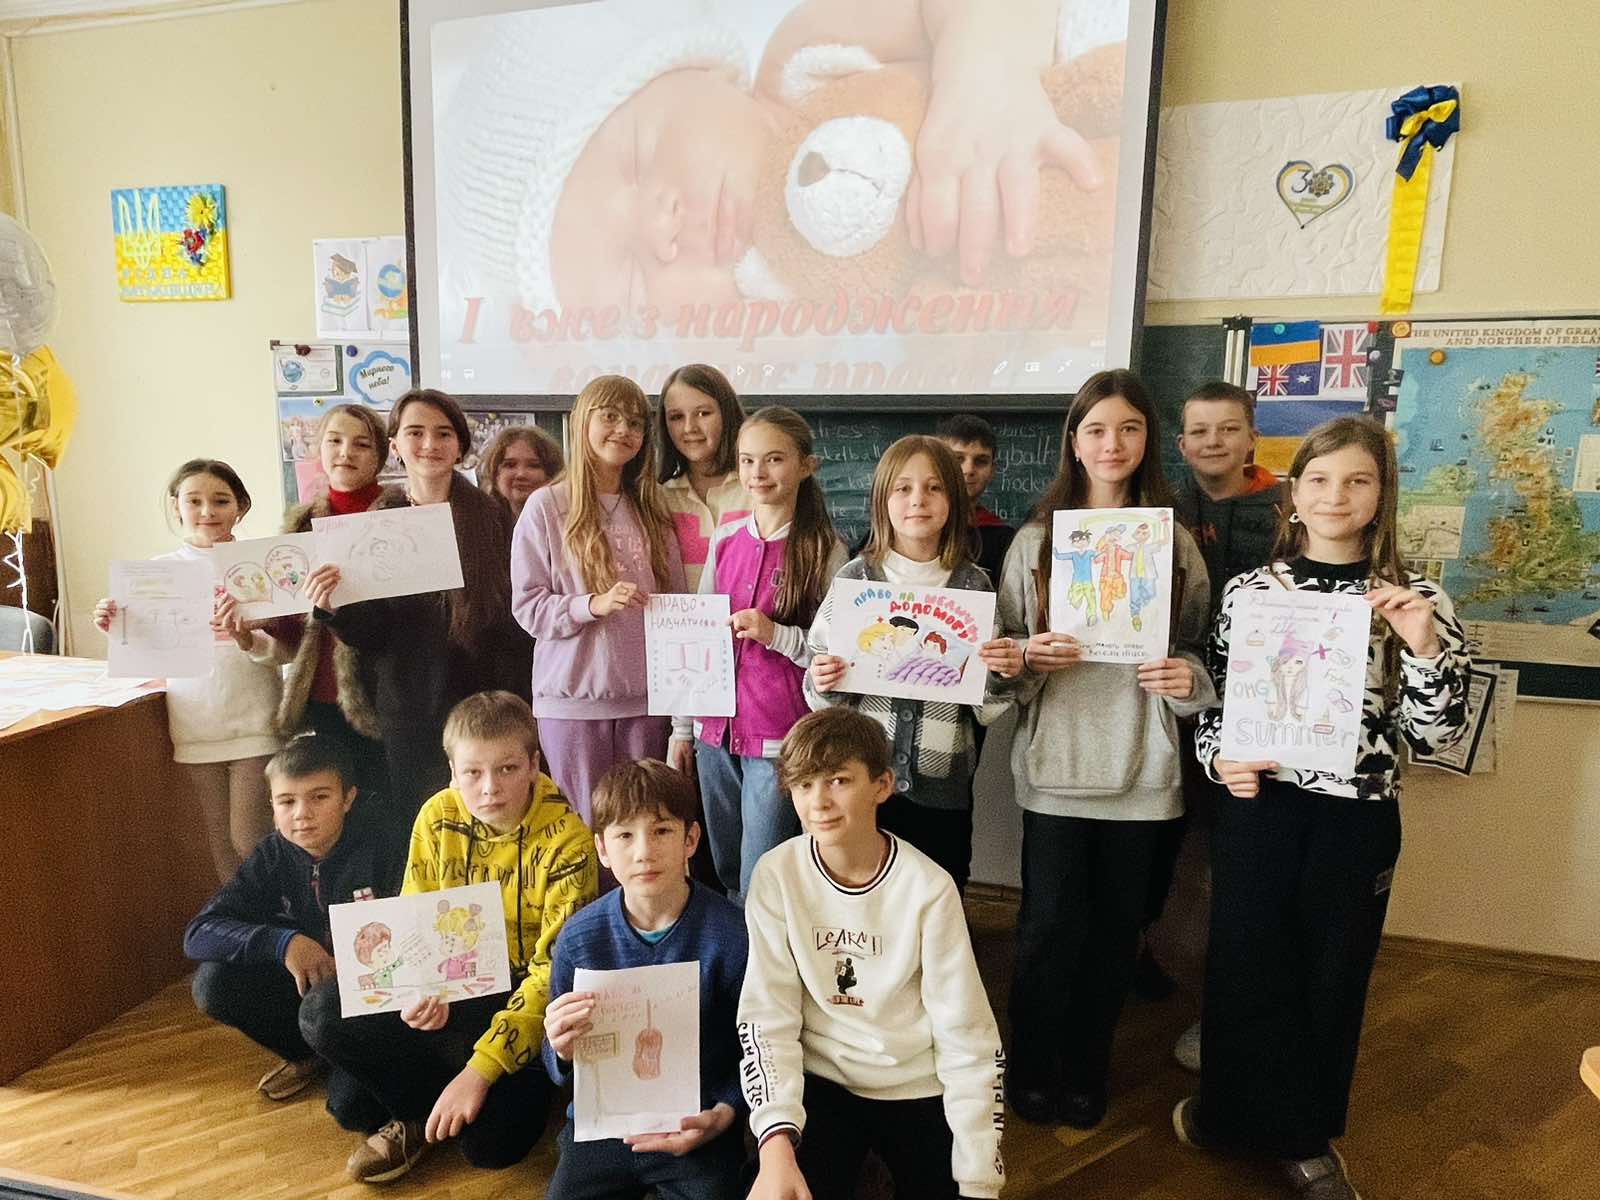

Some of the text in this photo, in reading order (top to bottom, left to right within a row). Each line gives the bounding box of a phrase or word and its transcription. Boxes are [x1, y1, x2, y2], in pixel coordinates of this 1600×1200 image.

[457, 296, 484, 344] І
[510, 302, 619, 343] вже
[674, 287, 1081, 353] народження
[1413, 326, 1600, 337] HE UNITED KINGDOM OF GREA
[1446, 336, 1474, 346] AND
[1478, 336, 1553, 345] NORTHERN
[1233, 679, 1269, 700] OMG
